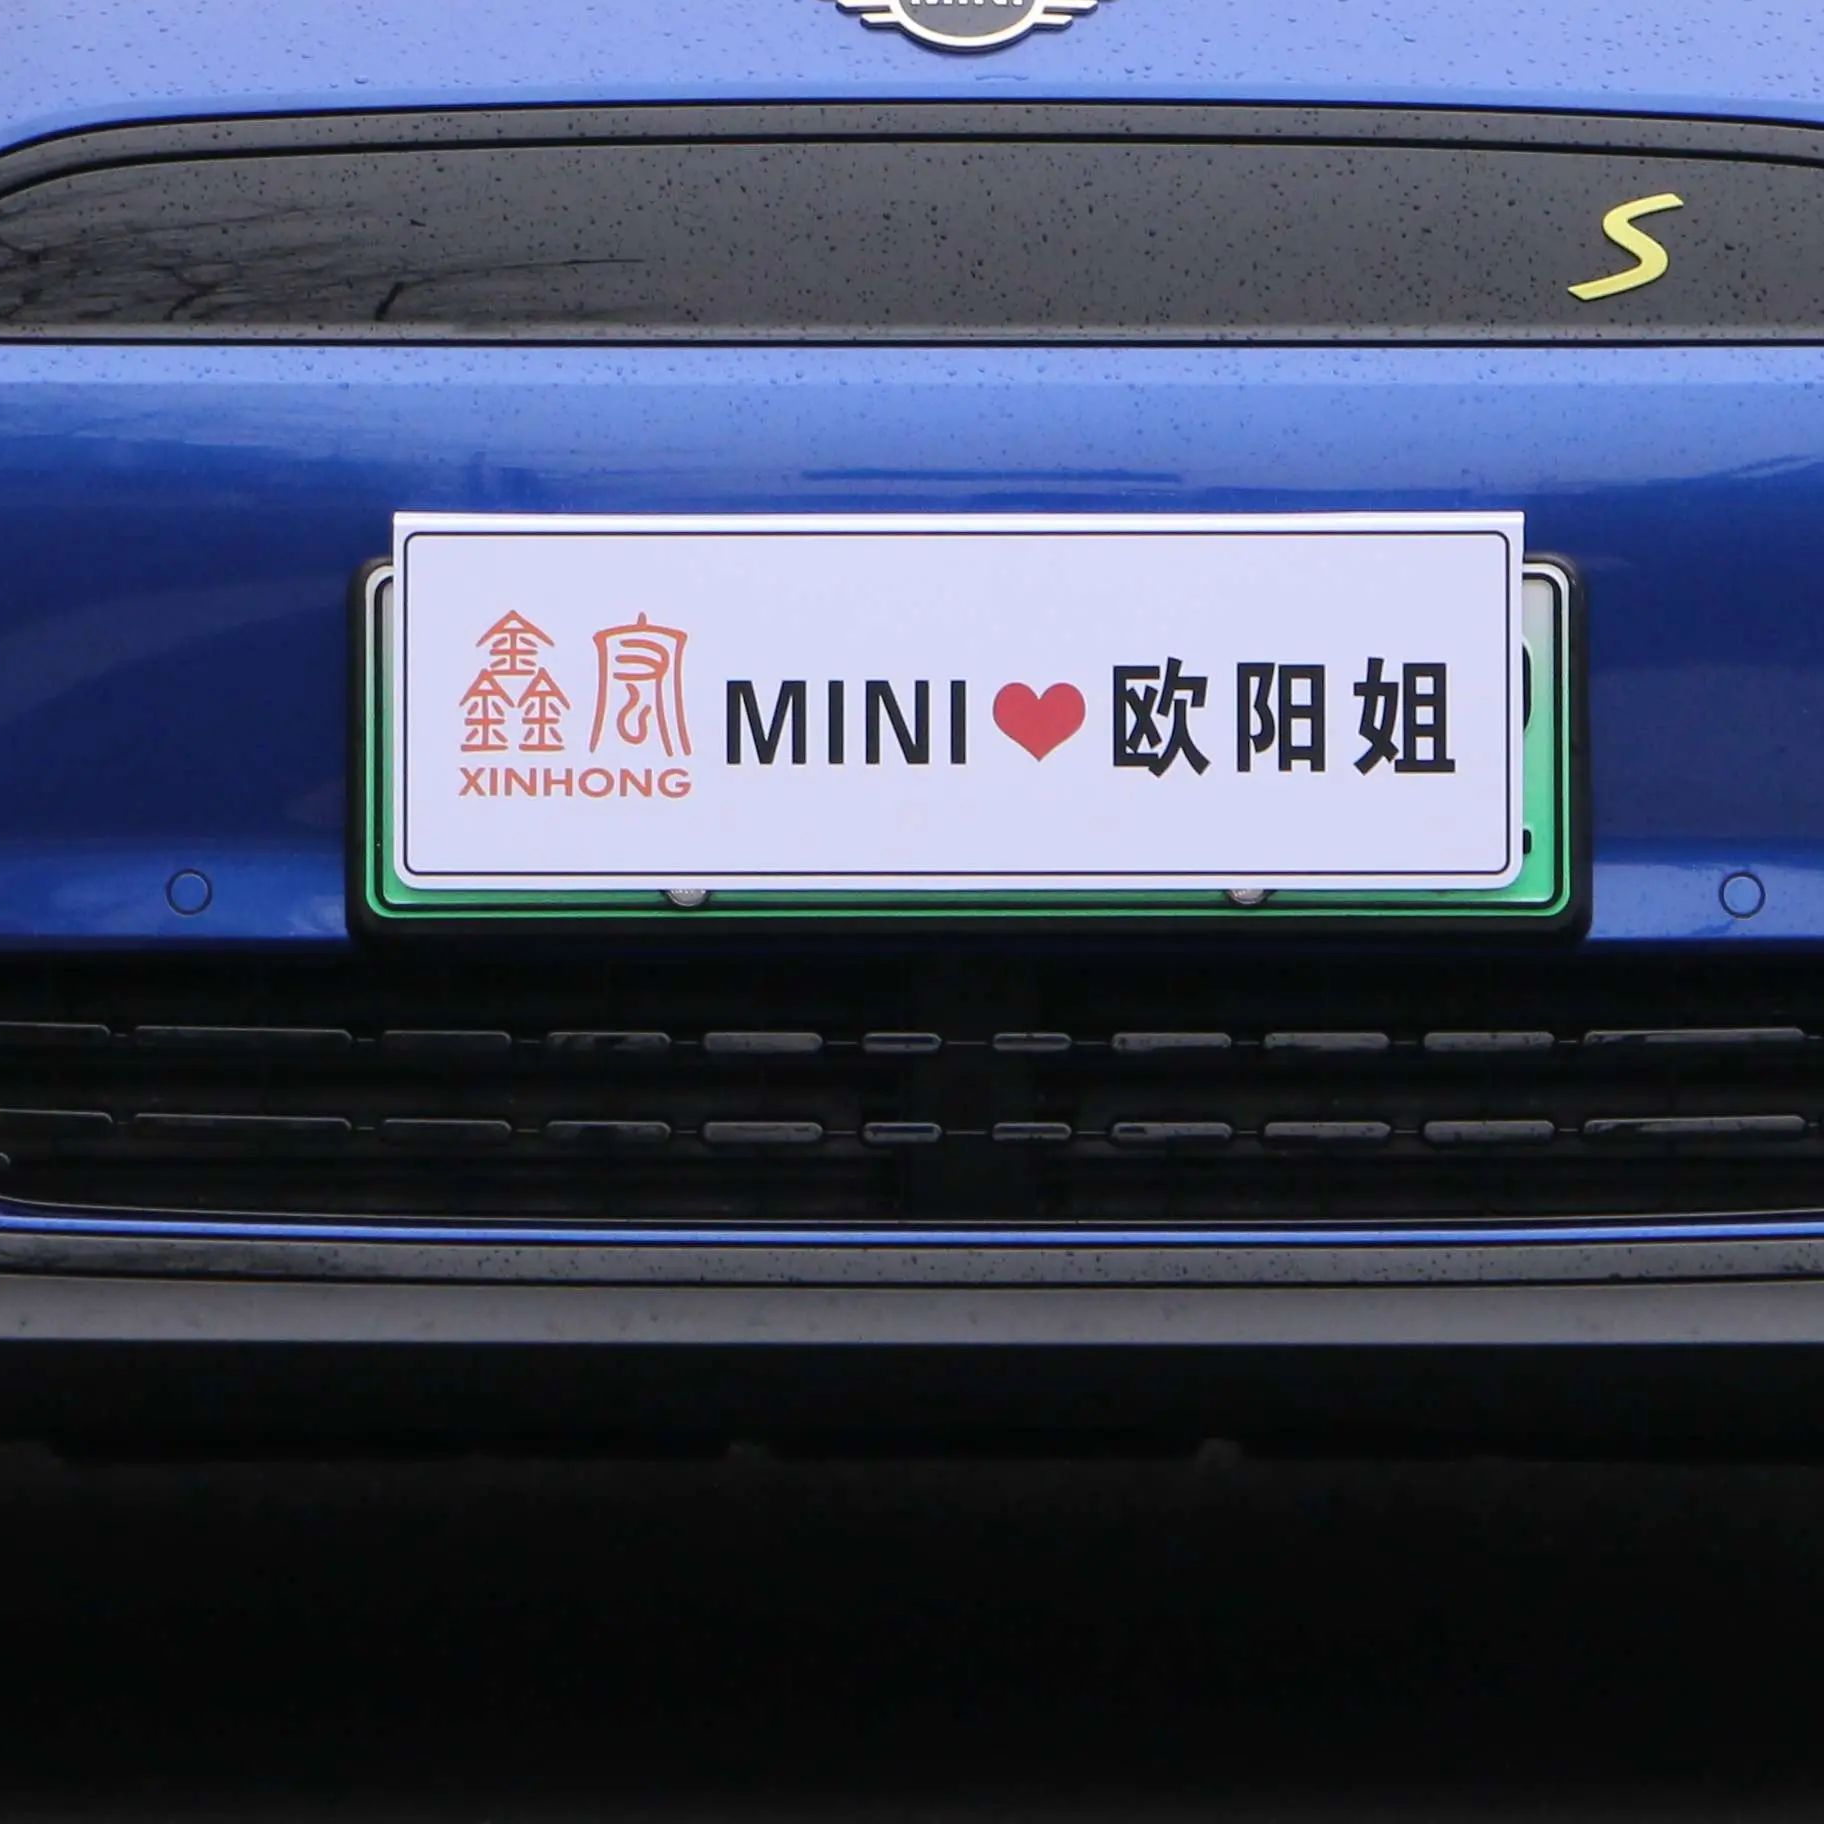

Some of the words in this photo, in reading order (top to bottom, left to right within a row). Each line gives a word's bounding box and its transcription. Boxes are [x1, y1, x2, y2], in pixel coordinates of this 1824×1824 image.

[1567, 192, 1684, 302] S
[726, 680, 966, 765] MINI
[1112, 656, 1456, 778] 欧阳姐
[458, 767, 692, 798] XINHONG
